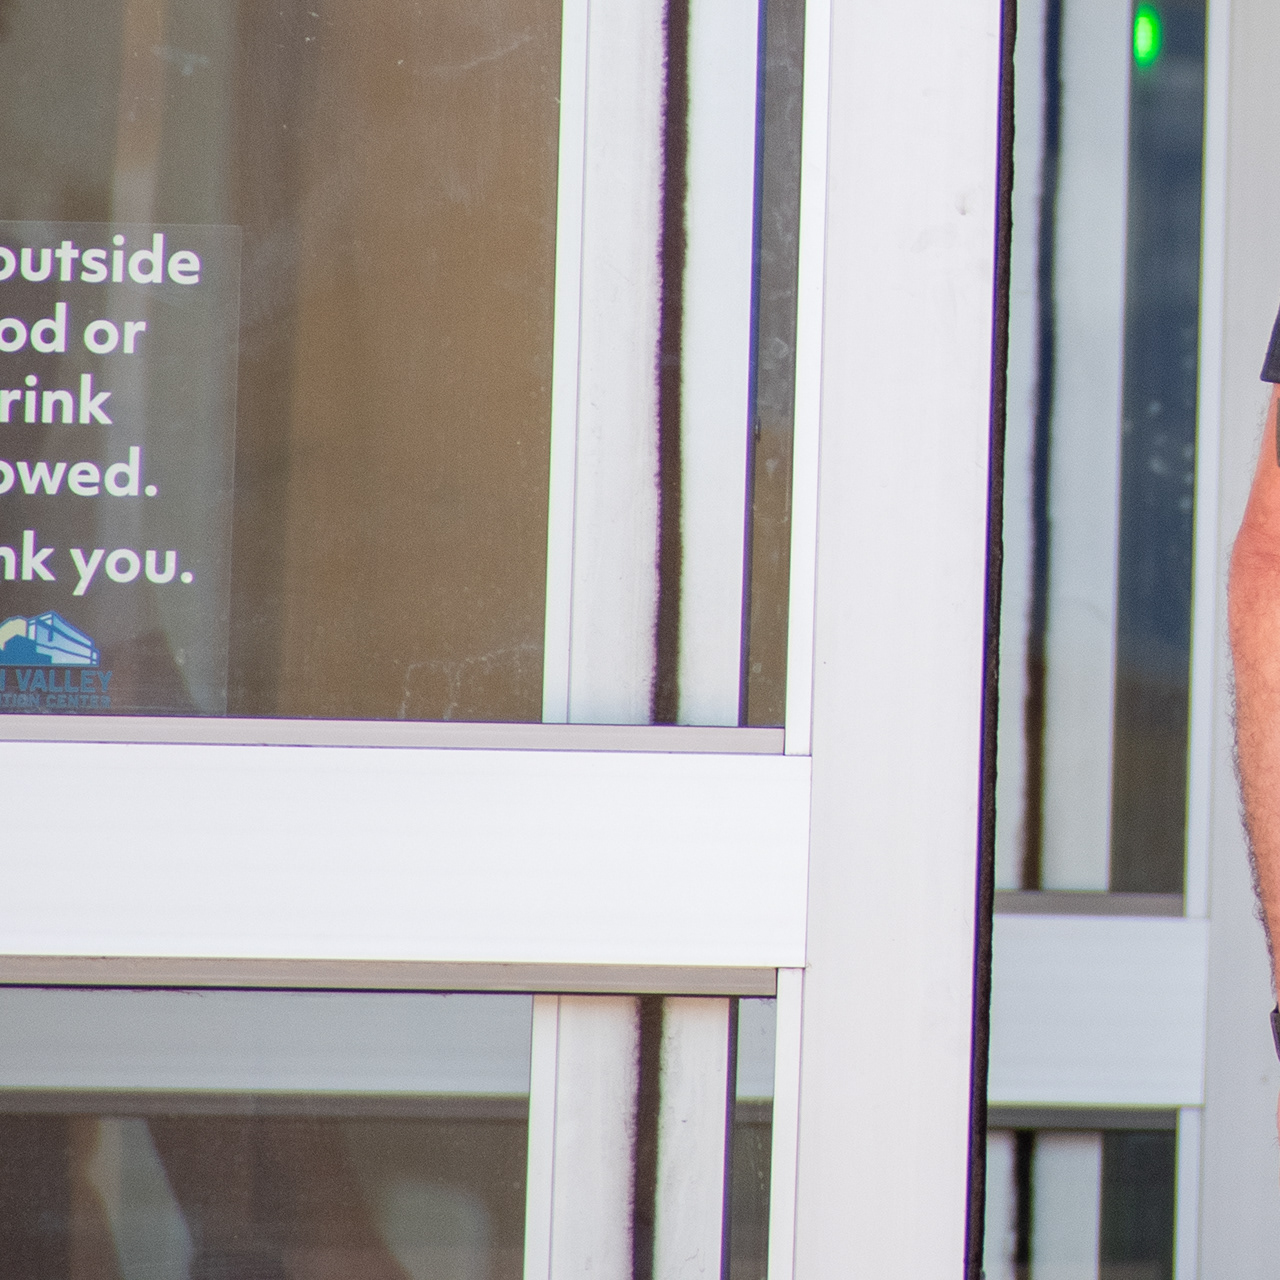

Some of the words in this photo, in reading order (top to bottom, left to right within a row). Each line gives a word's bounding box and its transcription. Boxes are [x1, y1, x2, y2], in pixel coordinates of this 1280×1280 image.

[84, 318, 147, 355] or
[69, 548, 193, 596] you.
[16, 668, 113, 693] VALLEY
[46, 693, 111, 709] CENTER
